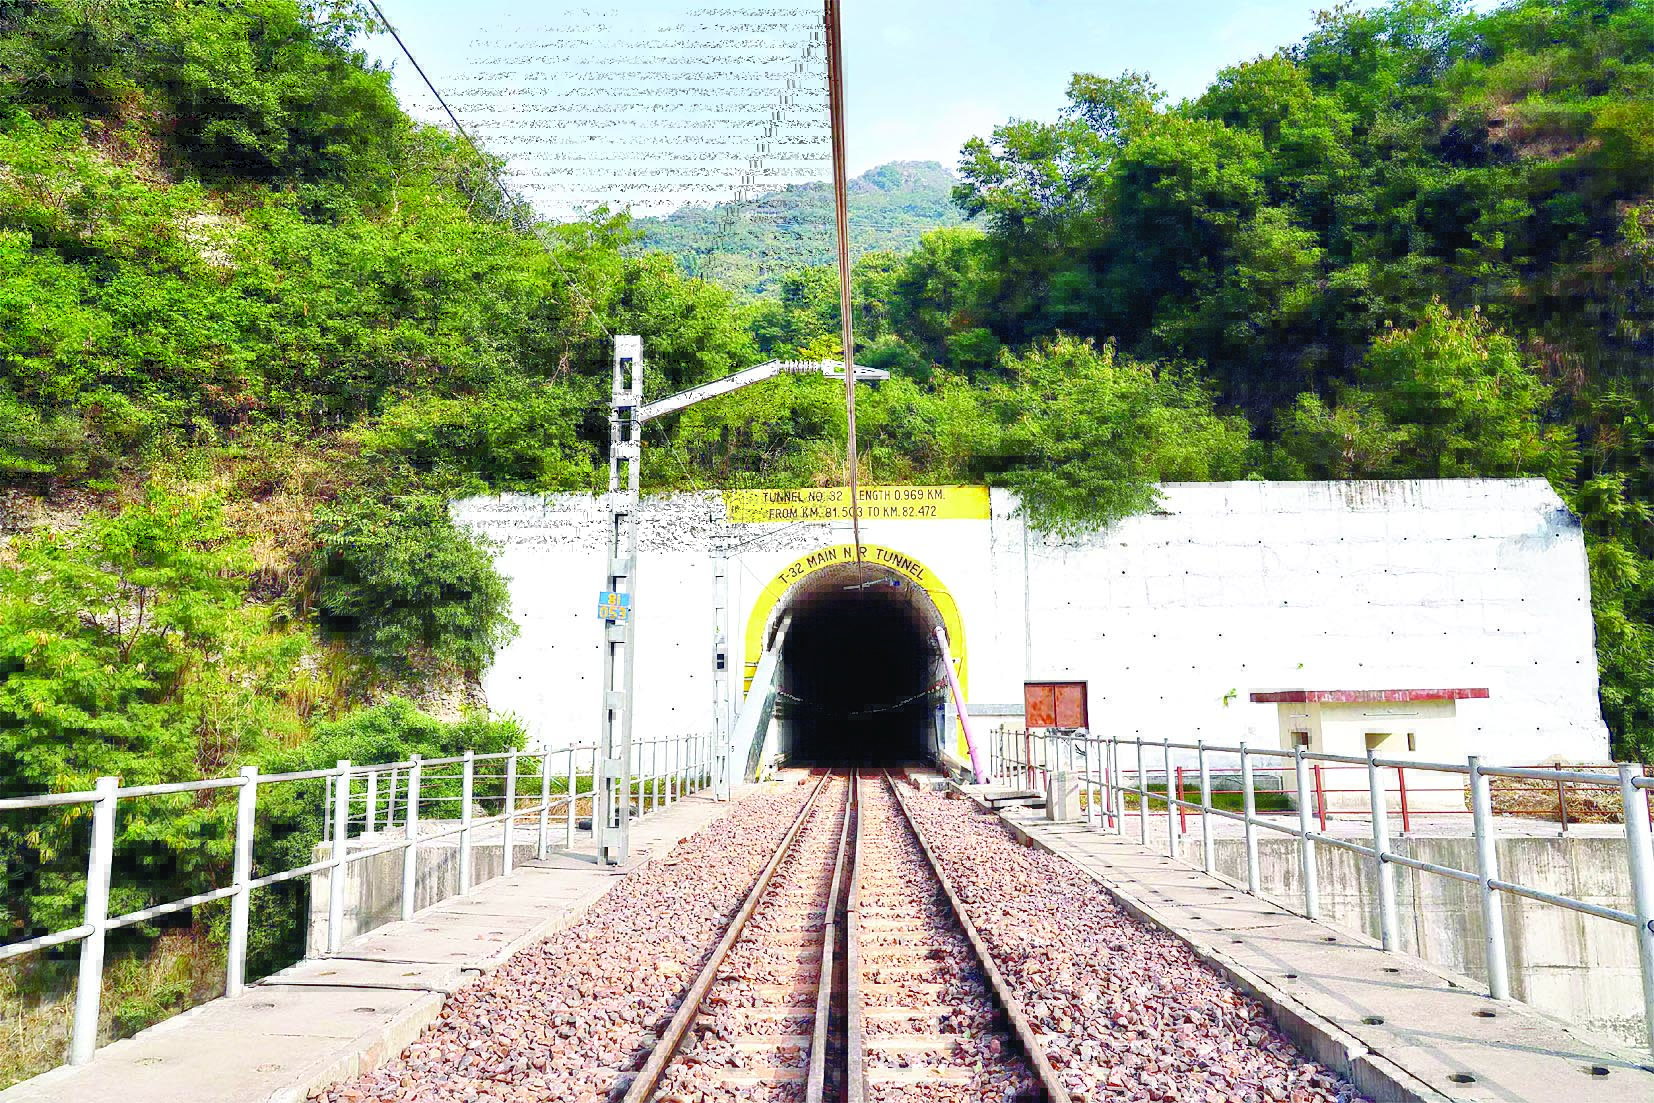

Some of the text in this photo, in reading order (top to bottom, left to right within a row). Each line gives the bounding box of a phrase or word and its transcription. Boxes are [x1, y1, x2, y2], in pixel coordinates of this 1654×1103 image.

[762, 491, 805, 503] TUNNEL
[829, 490, 843, 502] 32
[894, 489, 924, 501] 0.969
[768, 507, 798, 519] FROM
[867, 506, 880, 517] TO
[902, 505, 937, 517] 82.472
[778, 562, 805, 584] T-32
[806, 548, 837, 569] MAIN
[876, 548, 925, 581] TUNNEL
